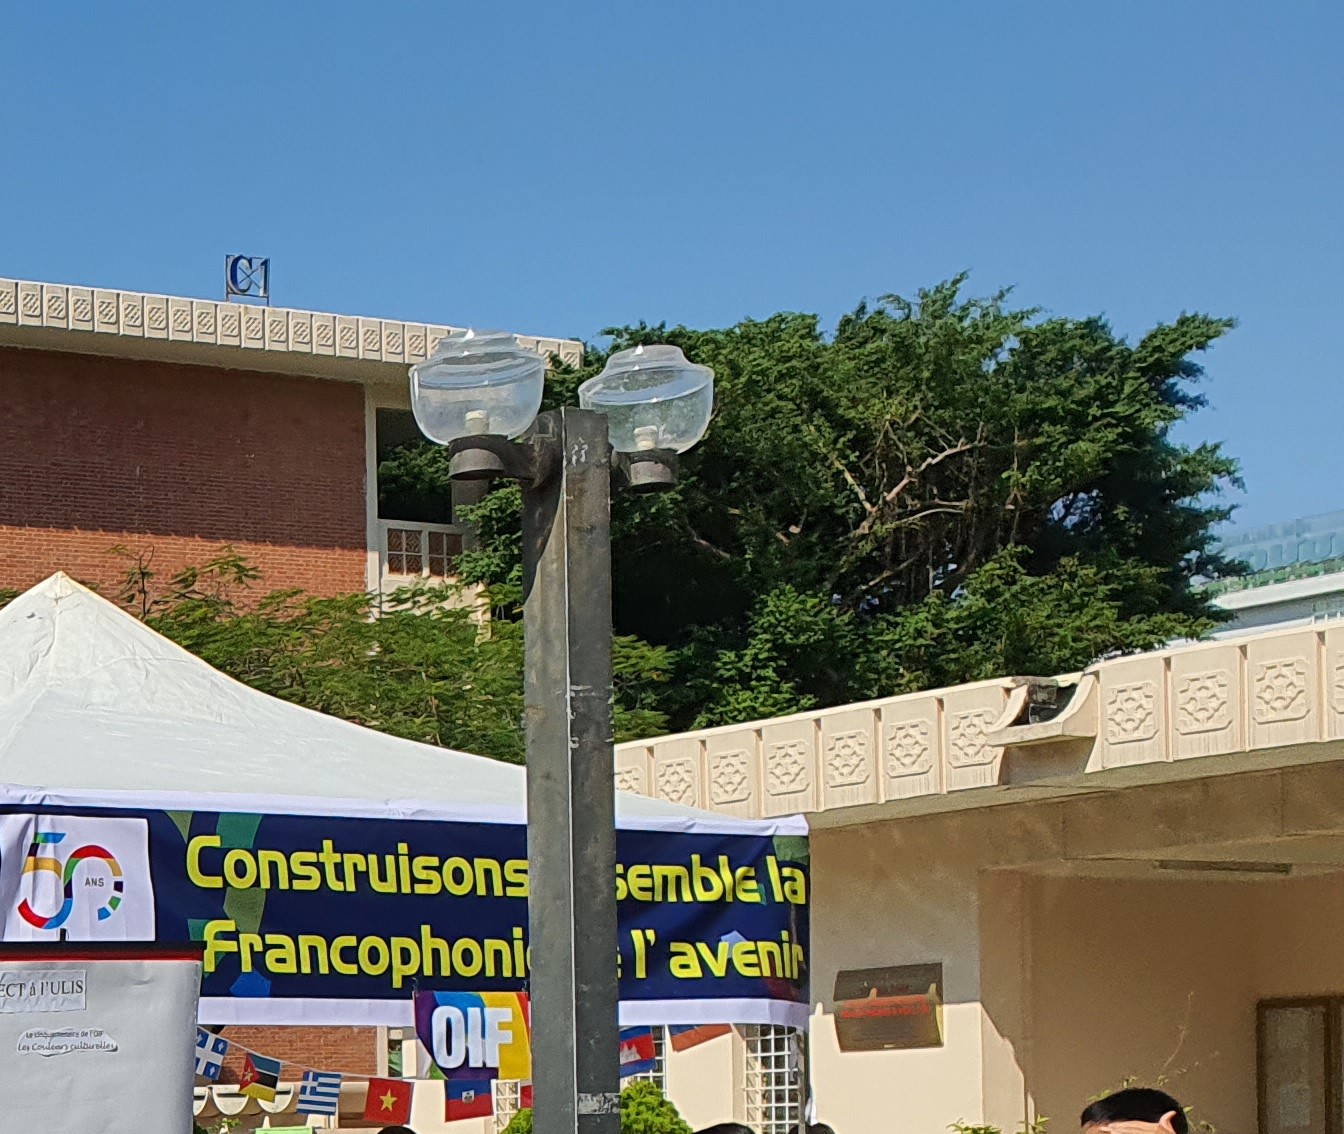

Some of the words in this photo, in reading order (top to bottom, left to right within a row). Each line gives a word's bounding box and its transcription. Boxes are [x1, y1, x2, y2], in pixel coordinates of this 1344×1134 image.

[229, 254, 269, 296] C1
[85, 877, 105, 887] ANS
[187, 835, 529, 897] Construisons
[616, 854, 762, 902] semble
[766, 855, 806, 904] la
[203, 920, 529, 989] Francophoni
[670, 930, 804, 979] avenir
[40, 980, 84, 996] l'ULIS
[432, 1005, 512, 1068] OIF
